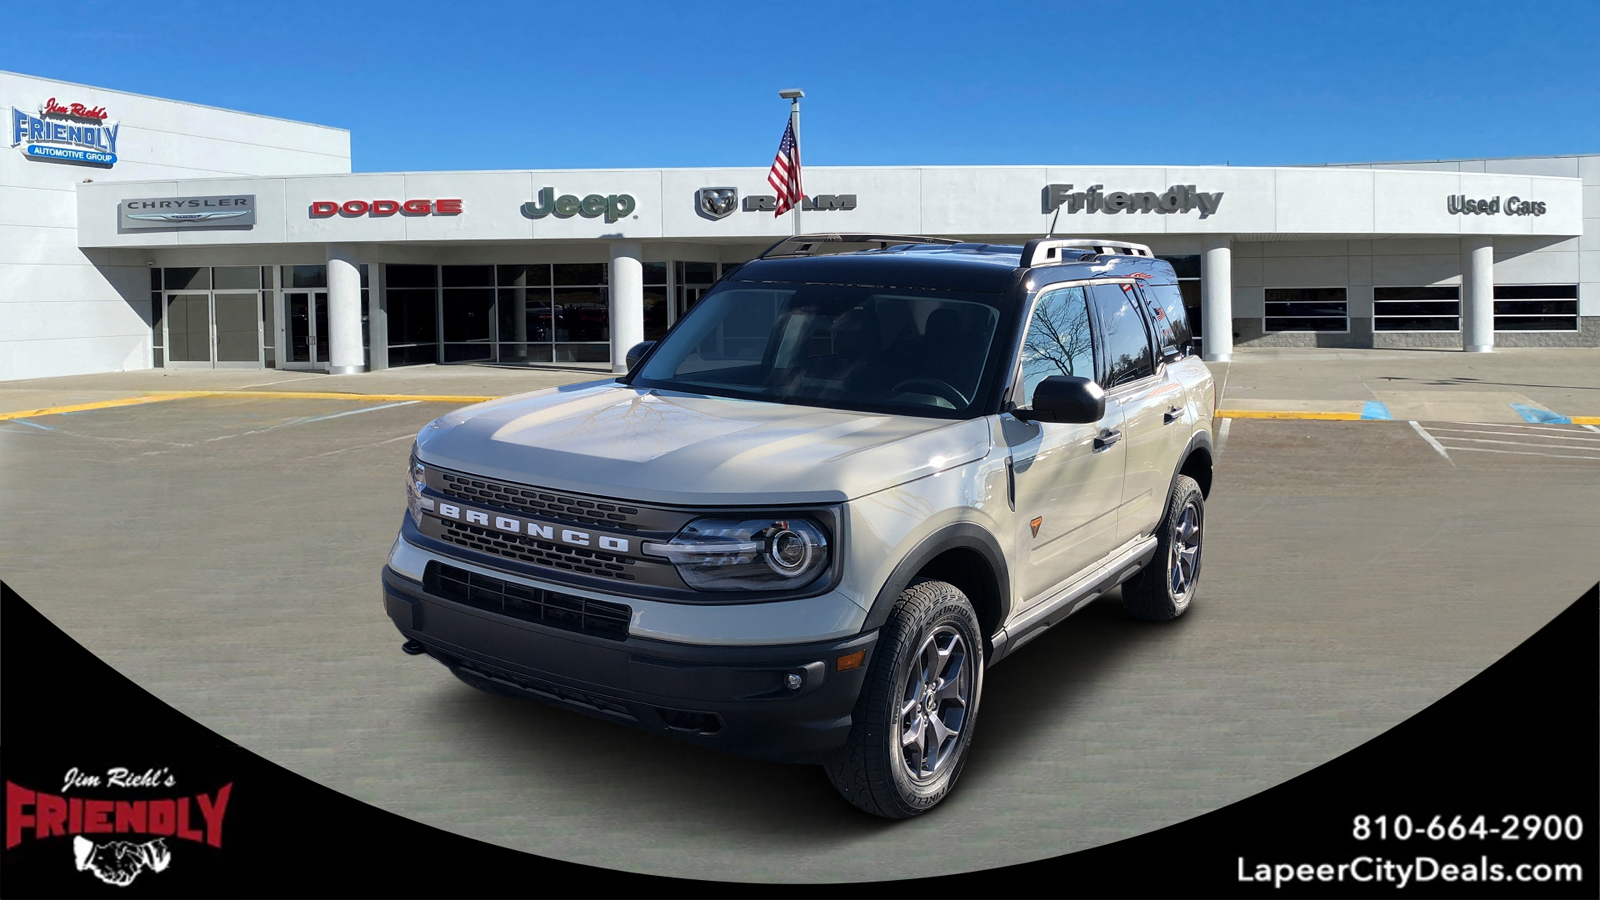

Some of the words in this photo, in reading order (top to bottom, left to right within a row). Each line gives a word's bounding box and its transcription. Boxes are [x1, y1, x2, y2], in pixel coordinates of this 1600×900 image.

[44, 97, 68, 114] Jim
[12, 105, 120, 153] FRIENDLY
[34, 146, 84, 159] AUTOMOTIVE
[86, 152, 113, 162] GROUP
[127, 198, 248, 210] CHRYSLER
[311, 199, 463, 216] DODGE
[523, 187, 636, 221] Jeep
[1042, 184, 1225, 219] Friendly
[1447, 194, 1501, 215] Used
[1503, 196, 1547, 216] Cars
[439, 502, 630, 552] BRONCO
